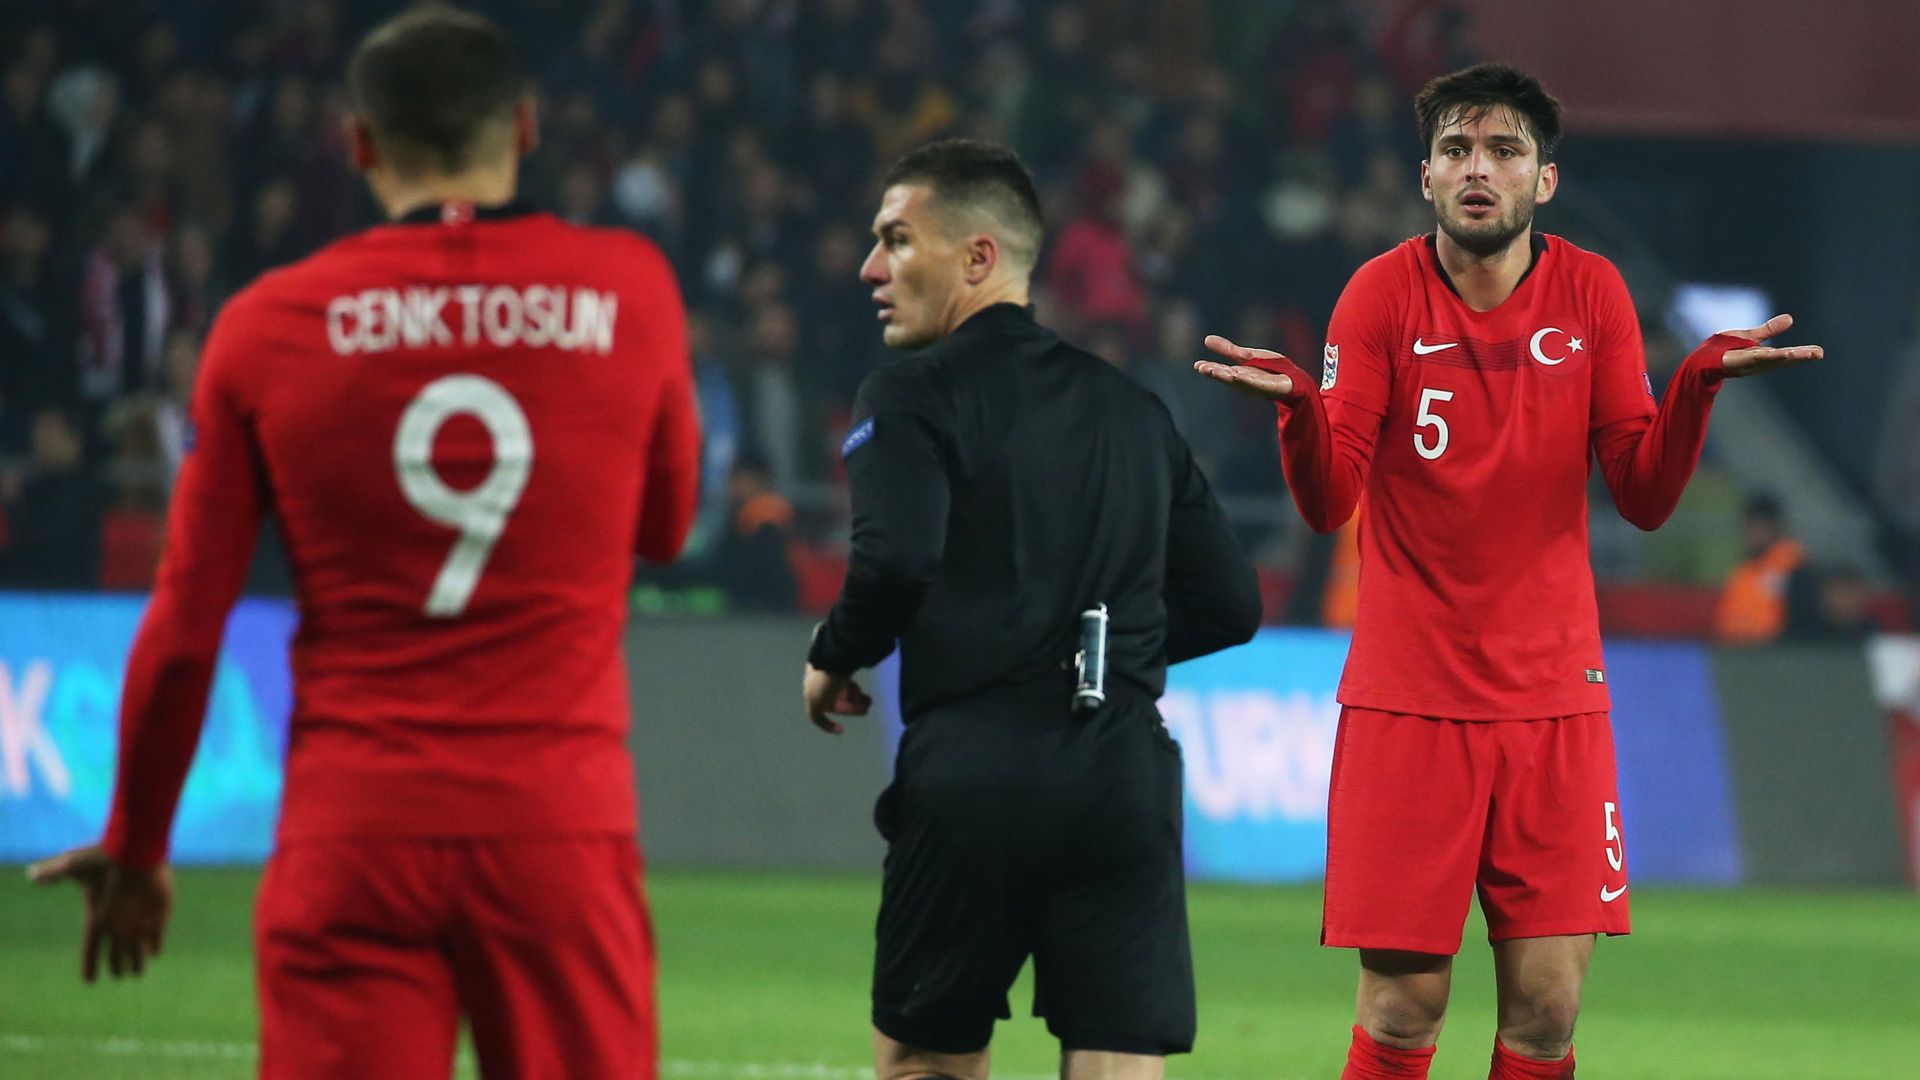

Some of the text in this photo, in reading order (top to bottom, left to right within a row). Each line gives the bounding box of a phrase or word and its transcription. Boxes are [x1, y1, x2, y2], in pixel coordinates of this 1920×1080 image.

[327, 284, 618, 356] CENK TOSUN
[1413, 388, 1454, 461] 5
[392, 373, 535, 618] 9
[1603, 801, 1623, 872] 5
